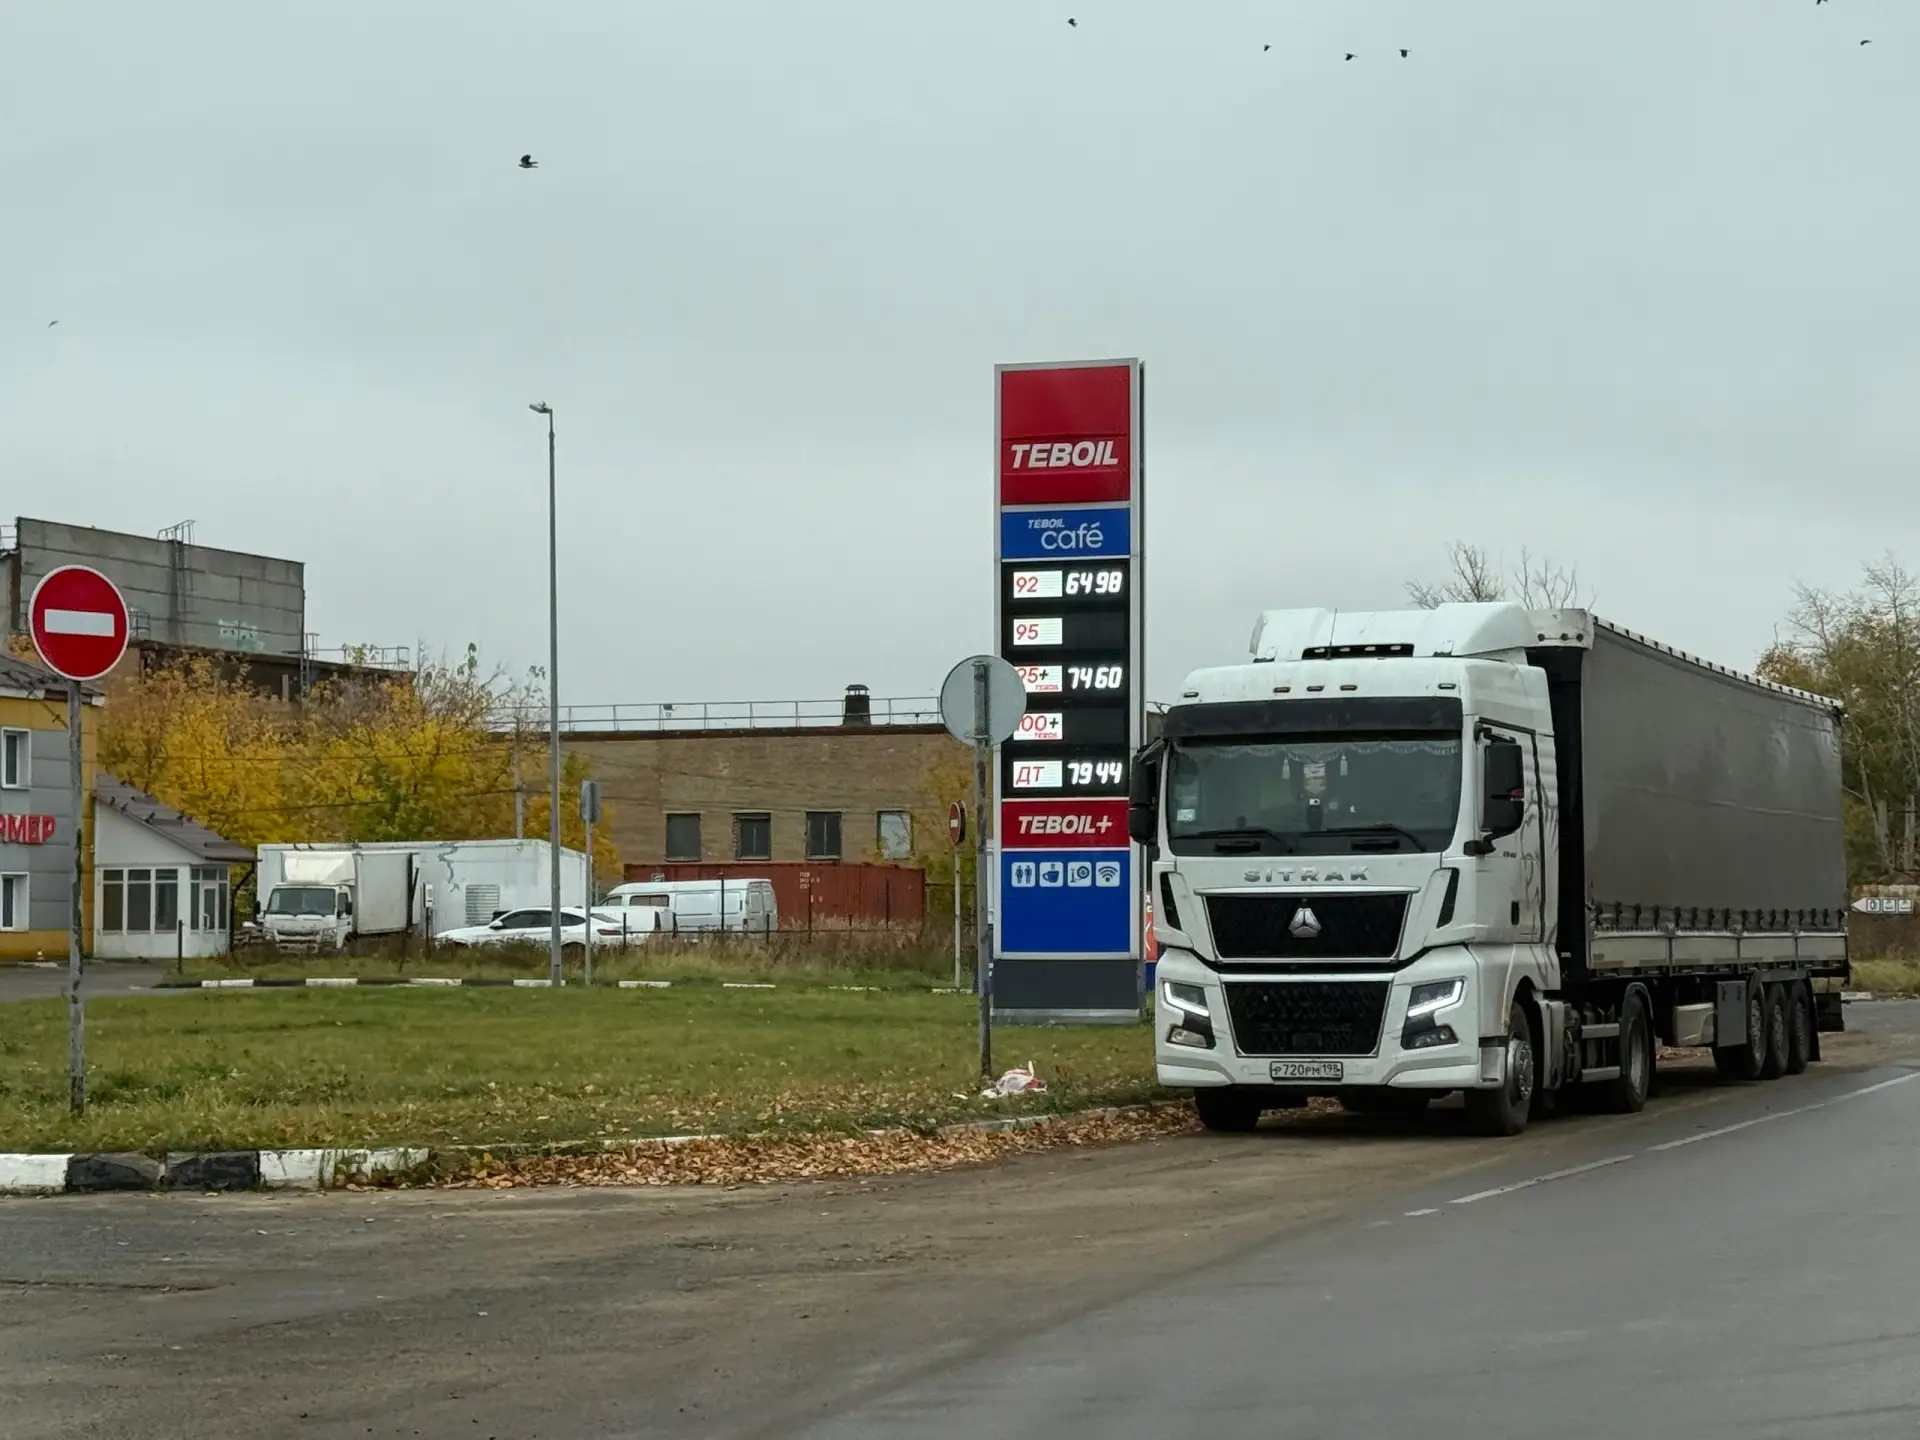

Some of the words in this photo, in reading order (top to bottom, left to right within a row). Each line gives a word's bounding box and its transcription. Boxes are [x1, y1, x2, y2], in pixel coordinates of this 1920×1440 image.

[1011, 441, 1119, 468] TEBOIL
[1028, 518, 1065, 529] TEBOIL
[1041, 522, 1103, 550] café
[1016, 576, 1039, 593] 92
[1016, 624, 1039, 640] 95
[1016, 766, 1045, 785] ДТ
[1018, 815, 1113, 834] TEBOIL+
[1244, 866, 1369, 882] SITRAK
